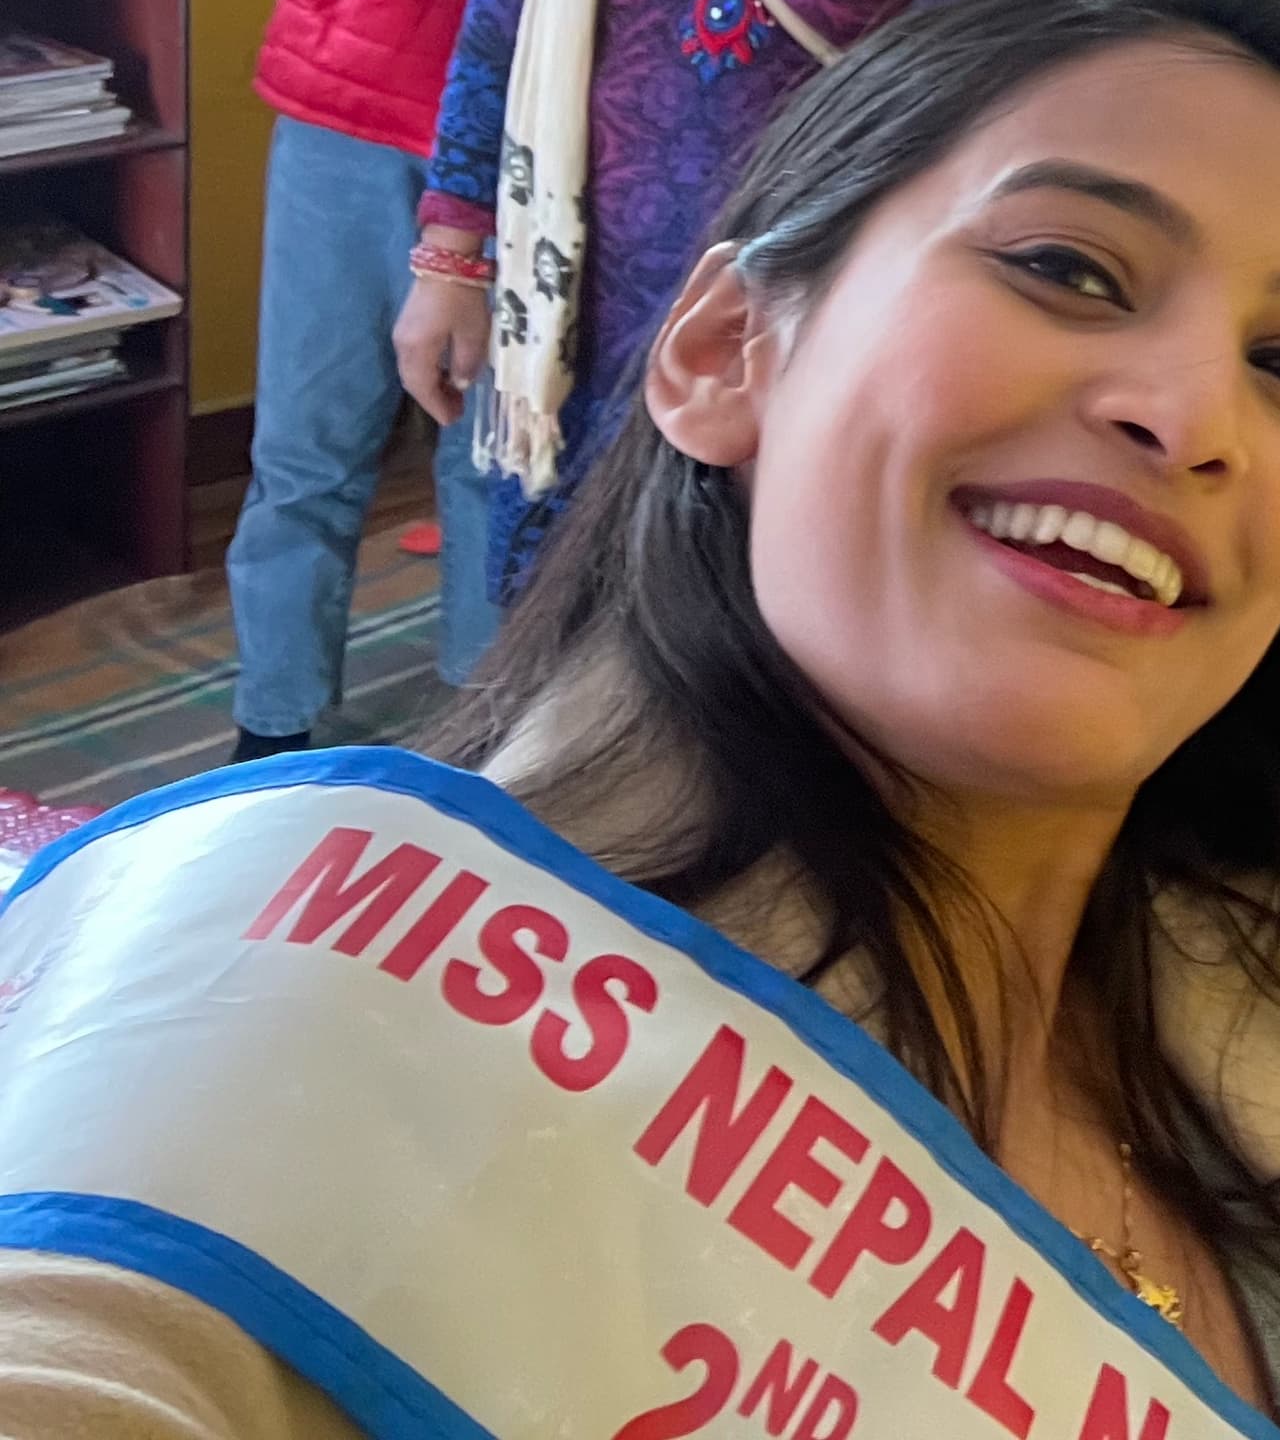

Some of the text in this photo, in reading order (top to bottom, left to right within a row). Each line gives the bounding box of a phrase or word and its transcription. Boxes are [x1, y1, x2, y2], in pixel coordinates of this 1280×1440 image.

[243, 827, 1037, 1440] MISS NEPAL
[611, 1322, 860, 1440] 2ND
